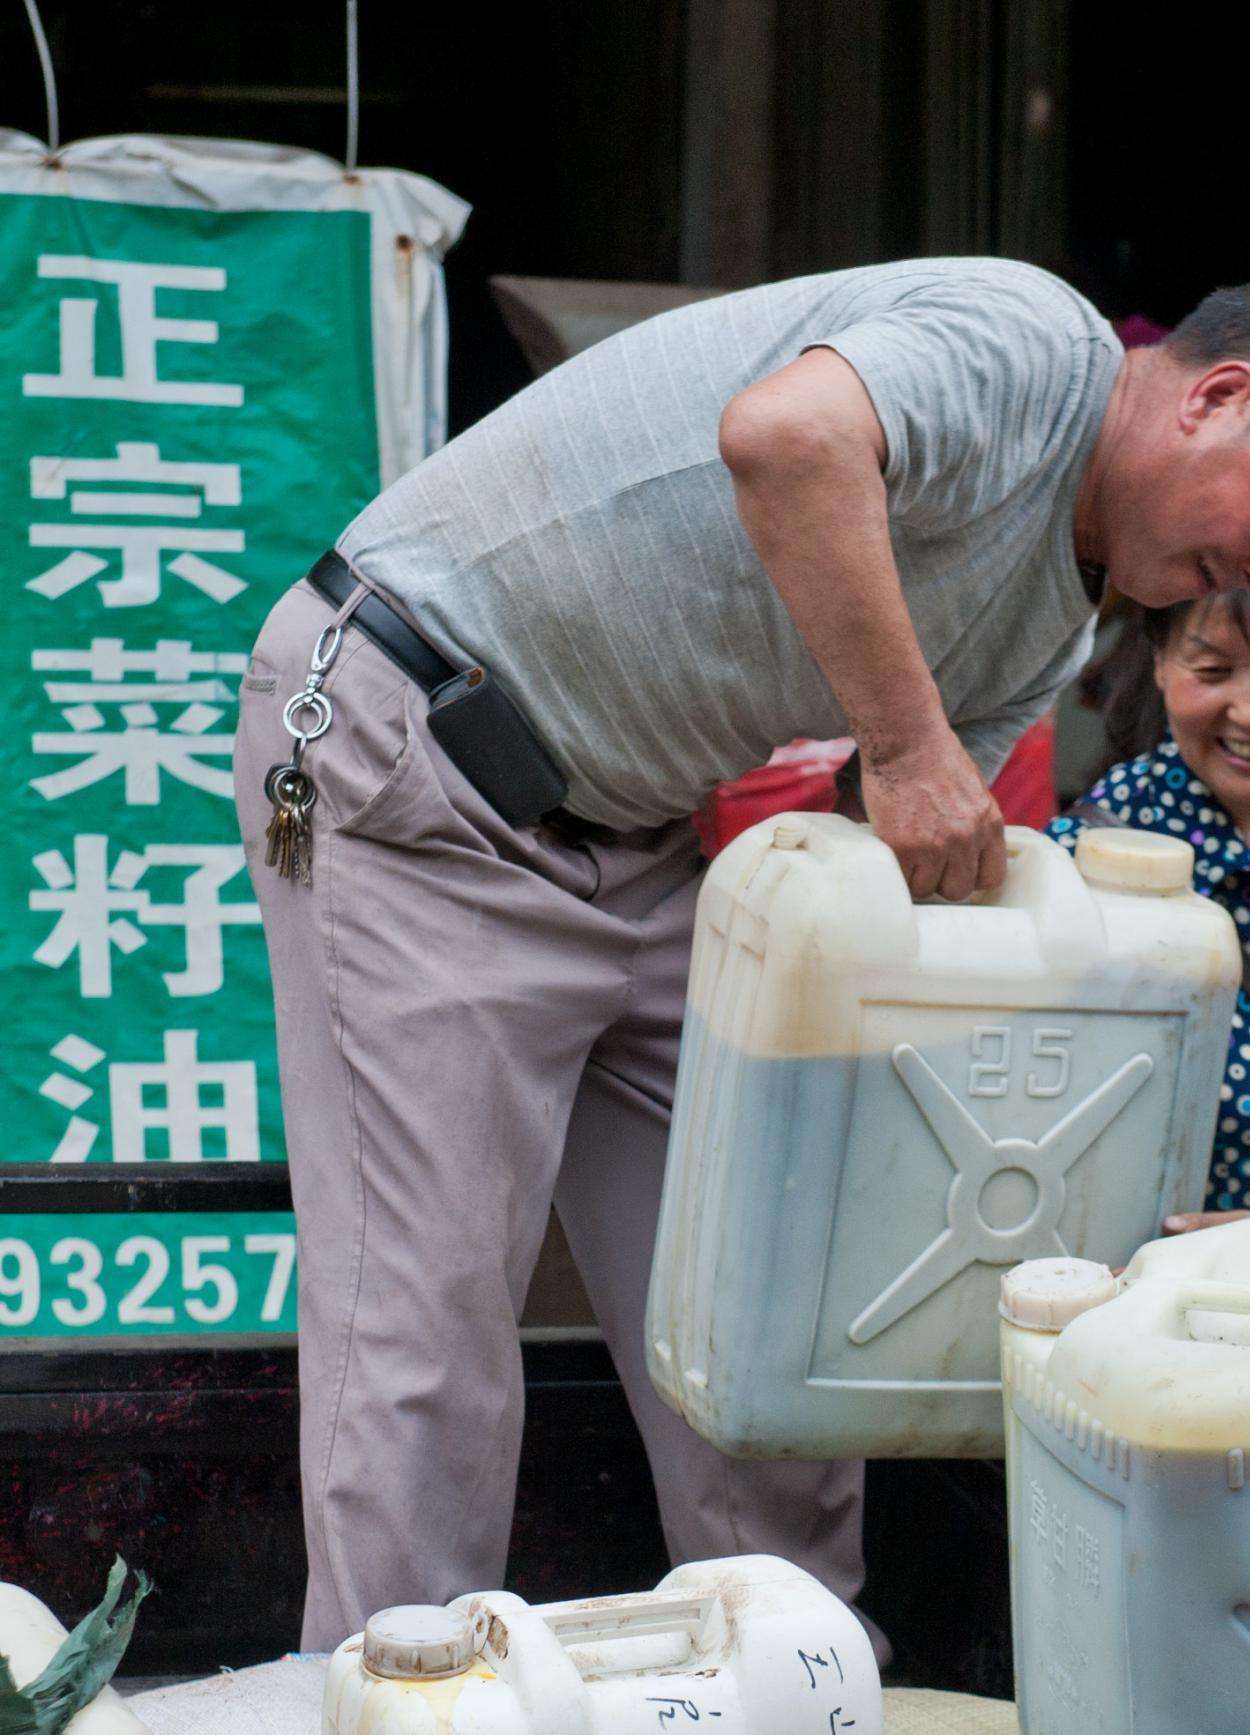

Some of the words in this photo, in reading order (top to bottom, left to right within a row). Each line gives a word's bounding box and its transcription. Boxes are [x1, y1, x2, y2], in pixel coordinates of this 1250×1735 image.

[22, 254, 262, 1163] 正宗菜籽油
[967, 1024, 1074, 1099] 25
[0, 1234, 297, 1327] 93257
